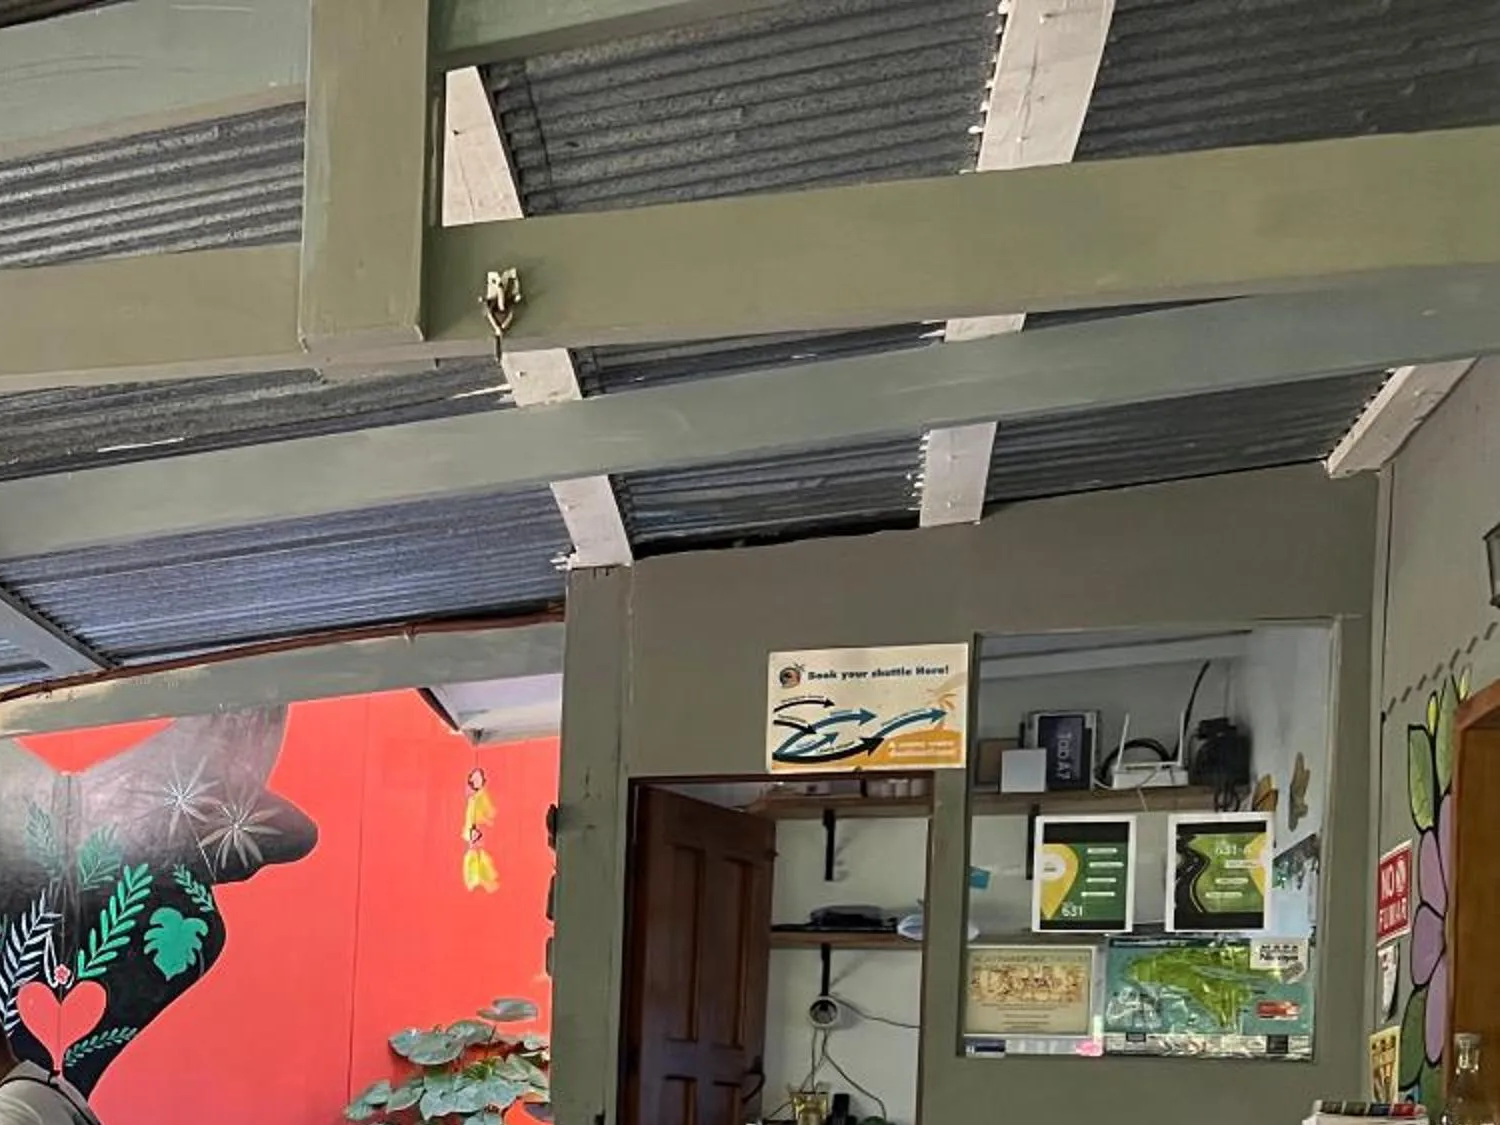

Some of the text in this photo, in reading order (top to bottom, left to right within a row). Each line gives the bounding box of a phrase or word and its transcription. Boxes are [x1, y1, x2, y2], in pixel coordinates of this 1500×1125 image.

[841, 671, 869, 681] your
[871, 666, 912, 678] shuttle
[1061, 904, 1083, 917] 631
